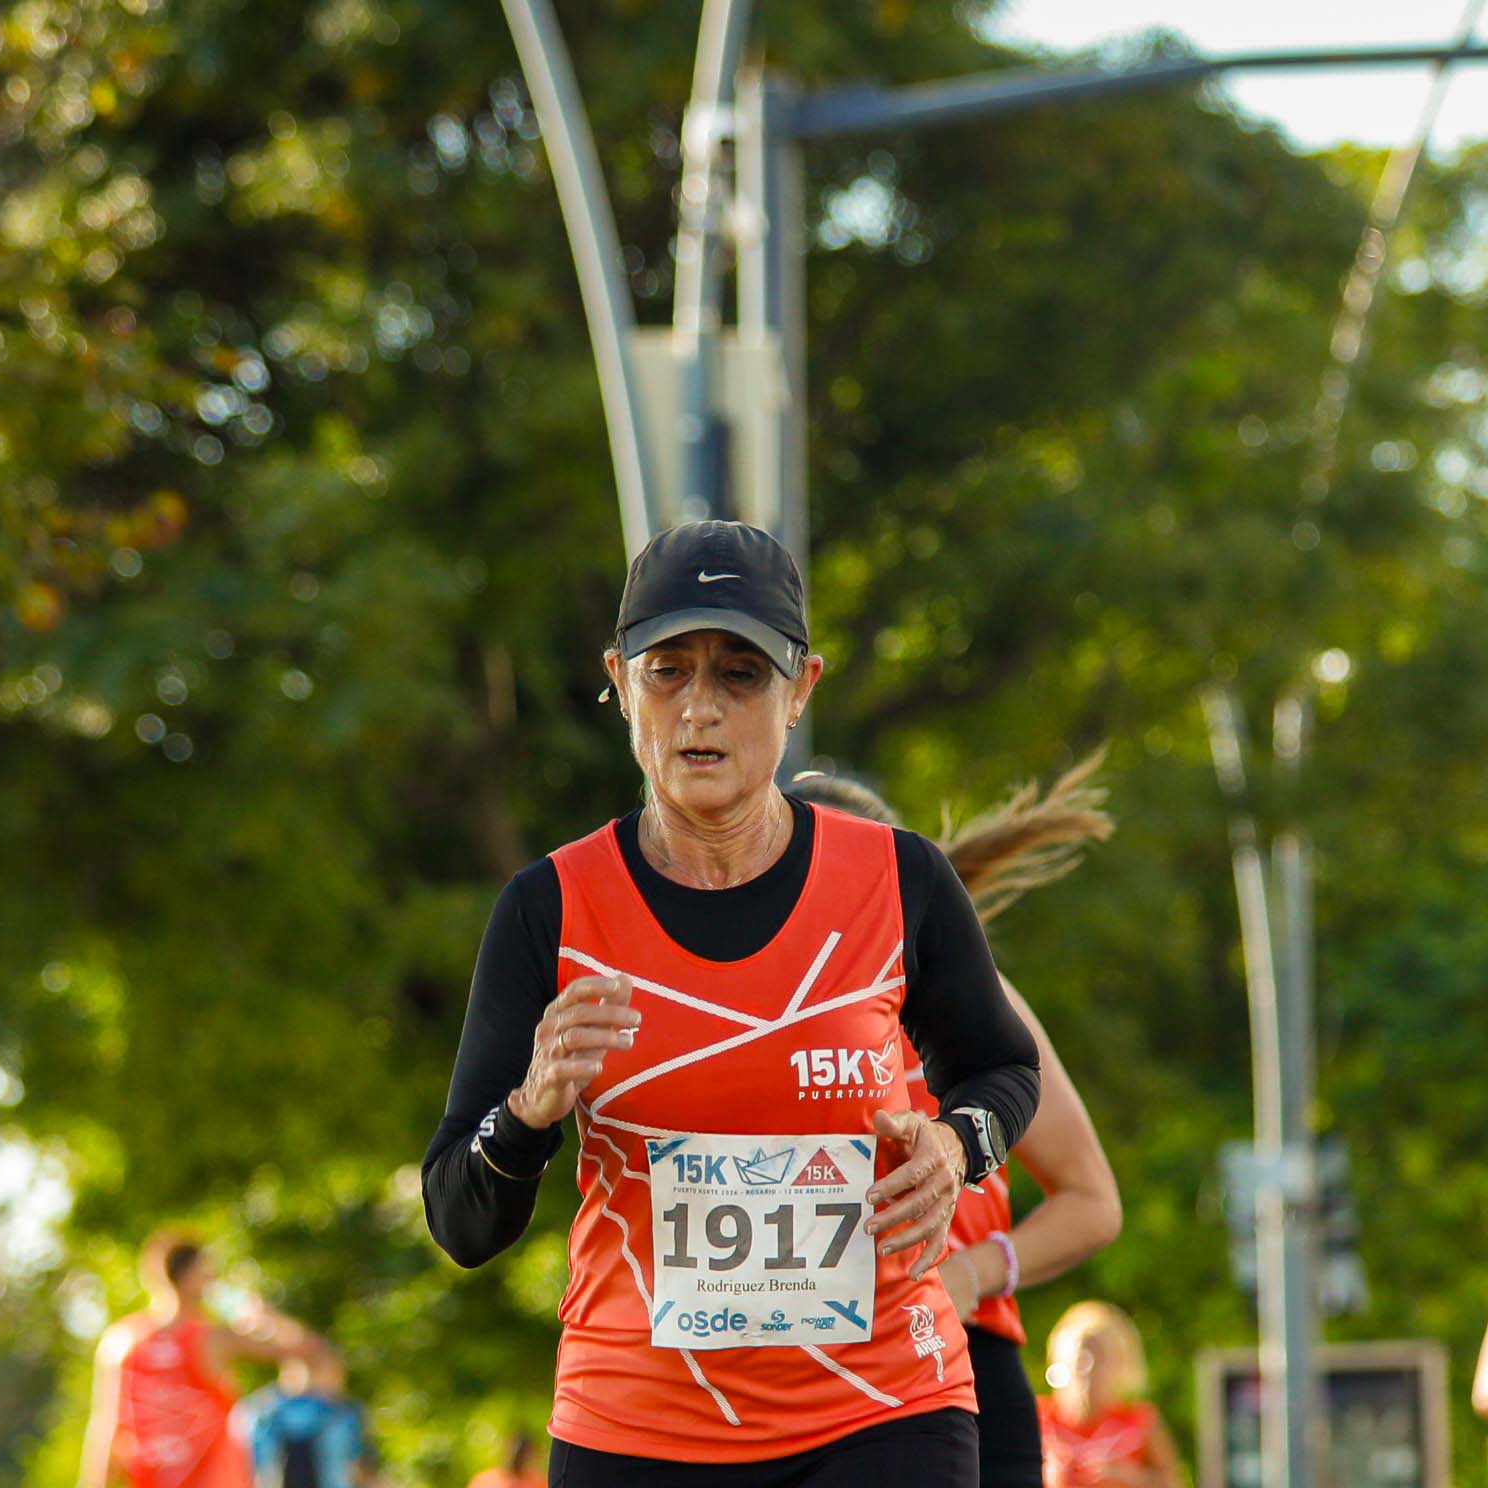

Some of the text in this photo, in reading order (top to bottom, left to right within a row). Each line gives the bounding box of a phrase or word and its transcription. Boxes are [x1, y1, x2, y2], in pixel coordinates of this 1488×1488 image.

[790, 1048, 865, 1087] 15K
[798, 1088, 864, 1101] PUERTO
[673, 1153, 728, 1185] 15K
[805, 1165, 836, 1180] 15K
[663, 1202, 862, 1272] 1917
[696, 1277, 817, 1295] Rodriguez Brenda
[677, 1308, 748, 1334] osde
